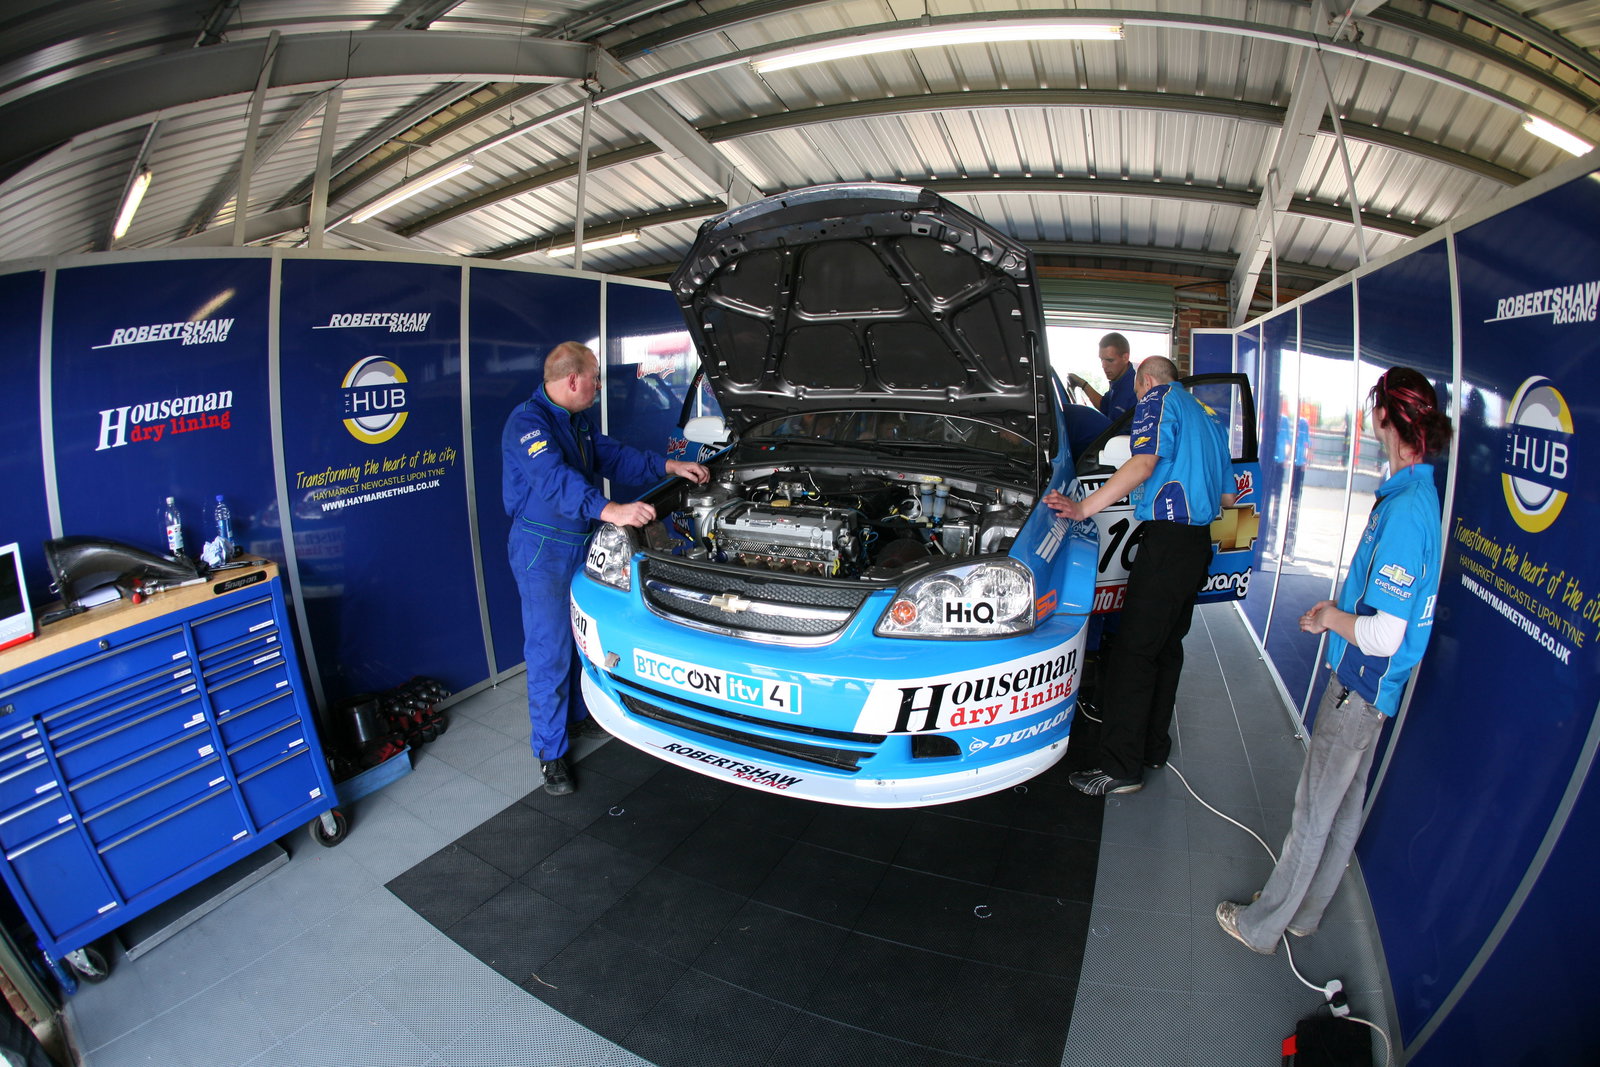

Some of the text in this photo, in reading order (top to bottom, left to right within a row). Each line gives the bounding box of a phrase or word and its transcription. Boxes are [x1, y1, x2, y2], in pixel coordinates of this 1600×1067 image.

[1496, 280, 1600, 319] ROBERTSHAW
[1553, 304, 1597, 325] RACING
[110, 318, 235, 346] ROBERTSHAW
[329, 312, 431, 327] ROBERTSHAW
[390, 323, 426, 333] RACING
[182, 332, 228, 346] RACING
[352, 388, 406, 413] HUB
[95, 390, 233, 451] Houseman
[131, 411, 231, 442] dry lining
[296, 446, 457, 490] Transforming the heart of the city
[1504, 432, 1569, 480] THE HUB
[313, 467, 446, 502] HAYMARKET NEWCASTLE UPON TYNE
[321, 479, 441, 512] WWW.HAYMARKETHUB.CO.UK
[588, 547, 606, 569] HiQ
[1453, 517, 1502, 569] Transforming
[1502, 543, 1519, 572] the
[1518, 552, 1548, 587] heart
[1546, 570, 1565, 599] of
[1562, 576, 1584, 611] the
[1374, 578, 1412, 599] CHEVROLET
[1459, 554, 1586, 648] HAYMARKET NEWCASTLE UPON TYNE
[945, 602, 995, 625] HiQ
[1461, 573, 1572, 665] WWW.HAYMARKETHUB.CO.UK
[635, 655, 784, 707] BTCC ON itv 4
[950, 674, 1073, 728] dry lining
[990, 703, 1074, 748] DUNLOP
[663, 743, 803, 786] ROBERTSHAW
[733, 771, 791, 790] RACING
